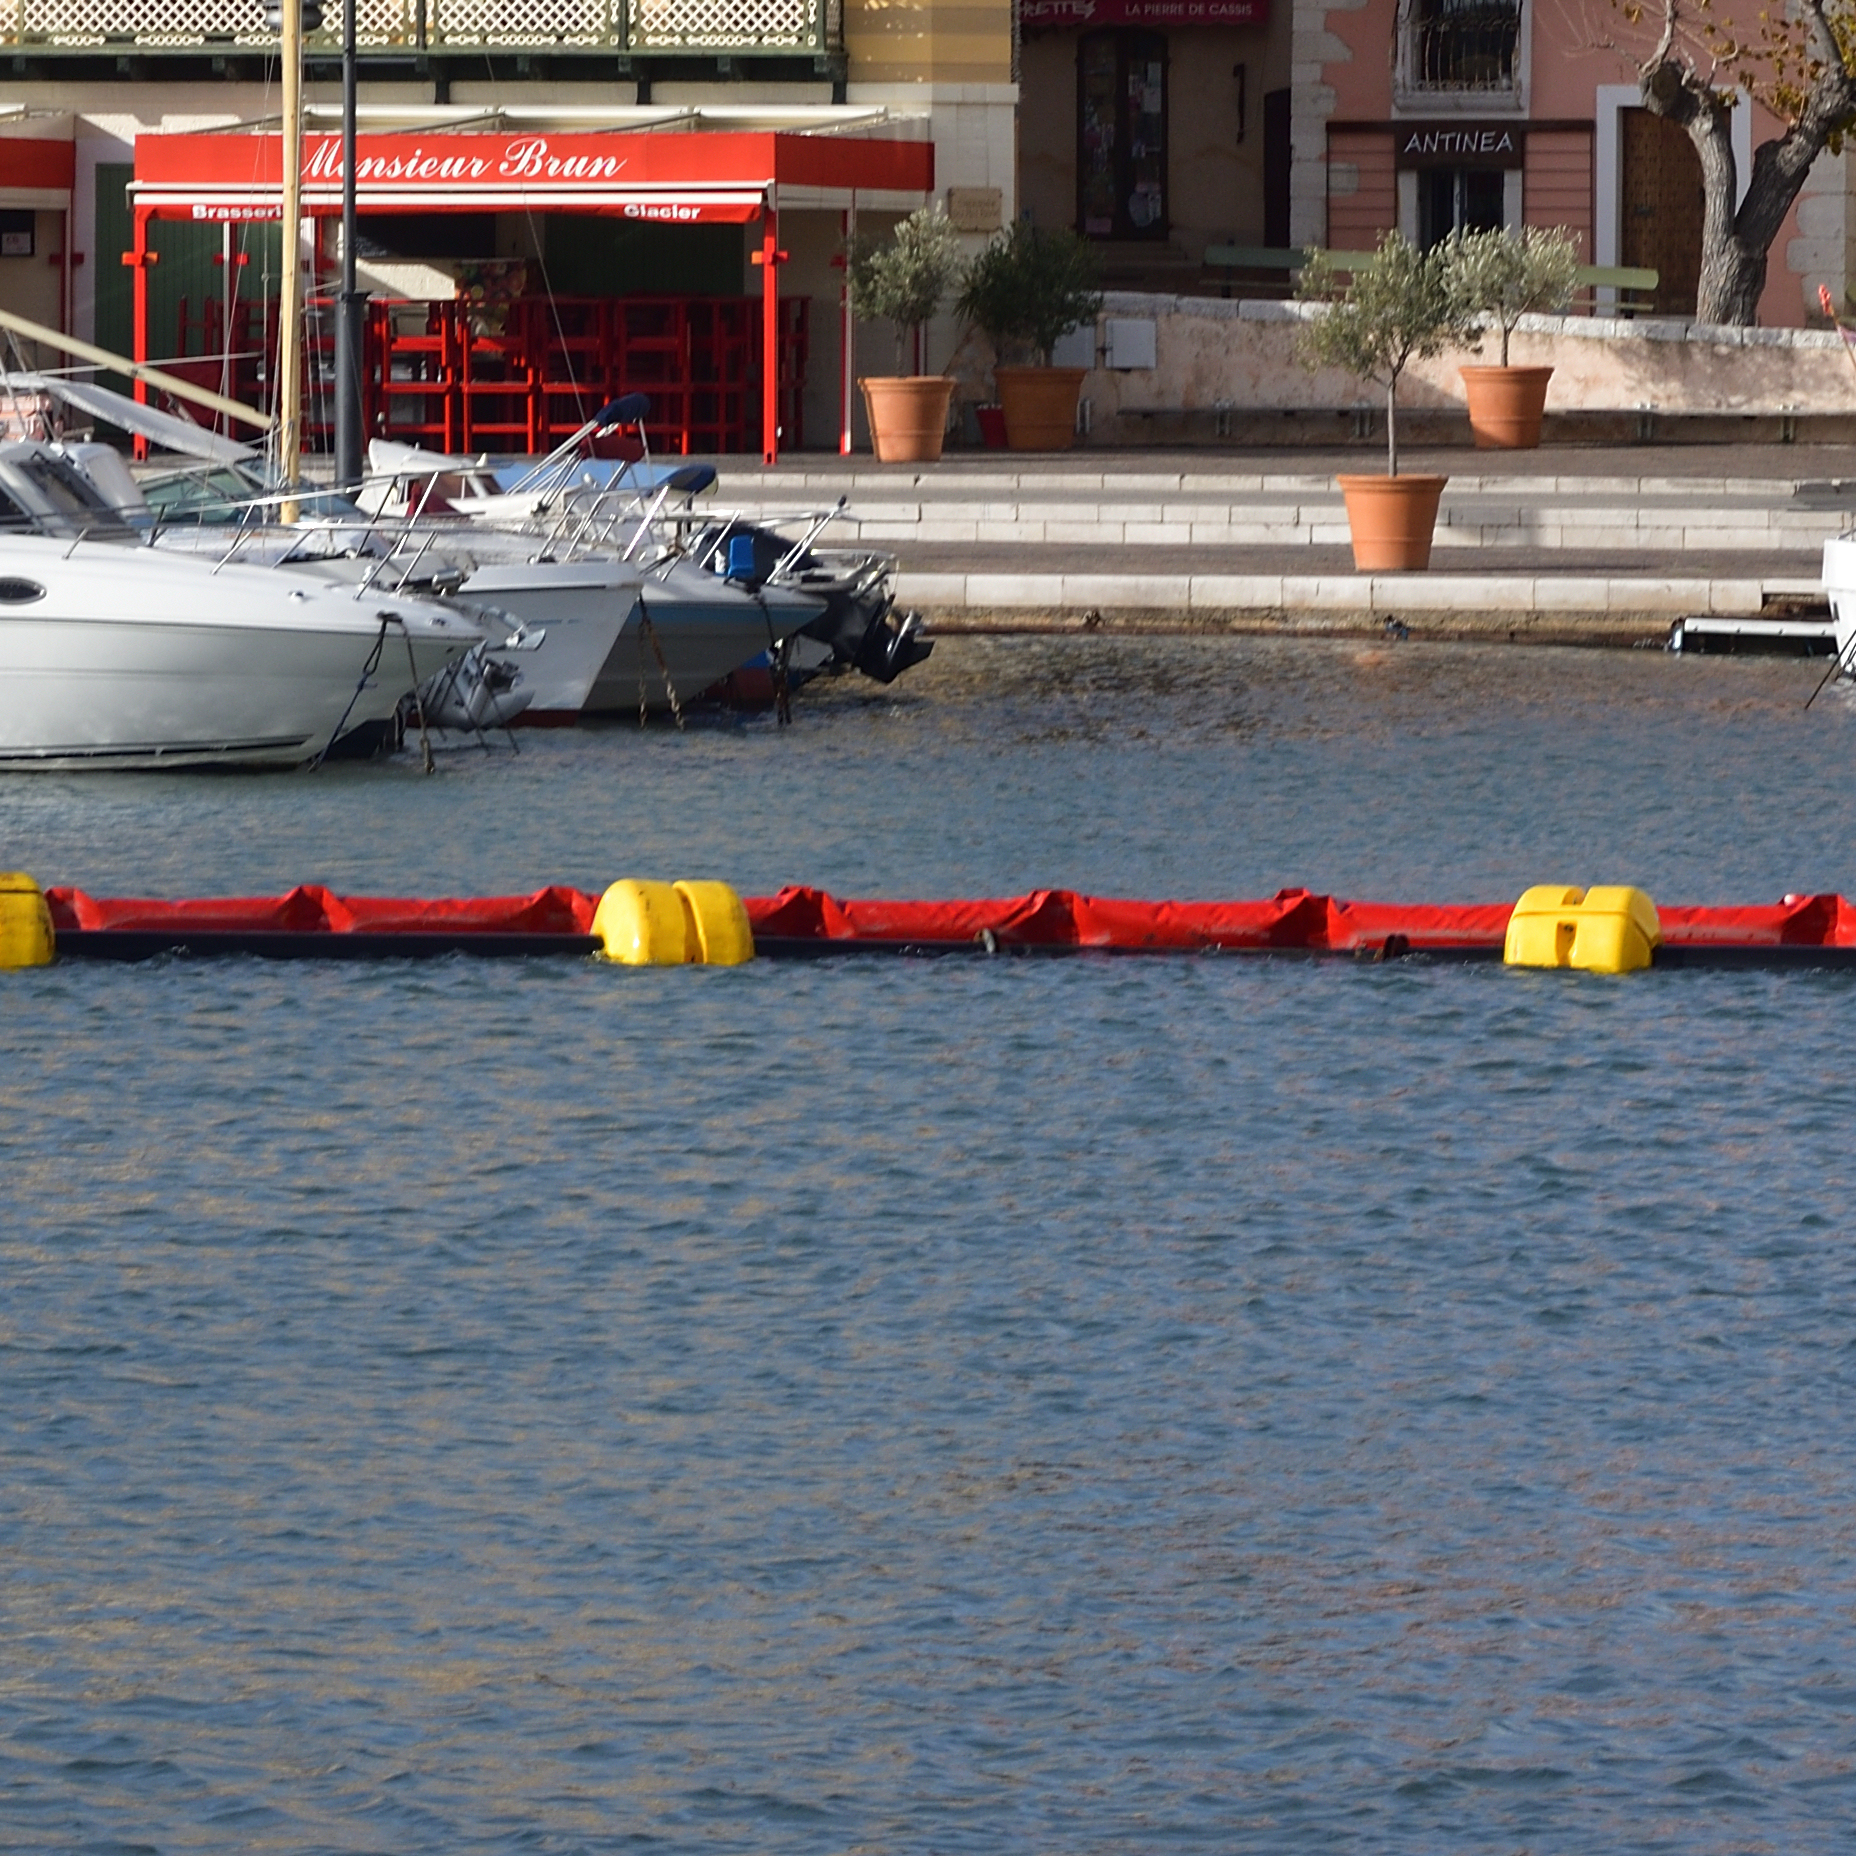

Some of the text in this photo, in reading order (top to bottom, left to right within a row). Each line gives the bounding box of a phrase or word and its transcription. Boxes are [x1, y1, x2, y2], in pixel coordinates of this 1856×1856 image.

[1125, 3, 1140, 16] LA
[1144, 3, 1184, 16] PIERRE
[1189, 3, 1205, 16] DE
[1209, 3, 1252, 16] CASSIS
[1404, 130, 1514, 153] ANTINEA
[499, 137, 628, 178] Brun
[192, 204, 701, 221] Brasseri Glacier
